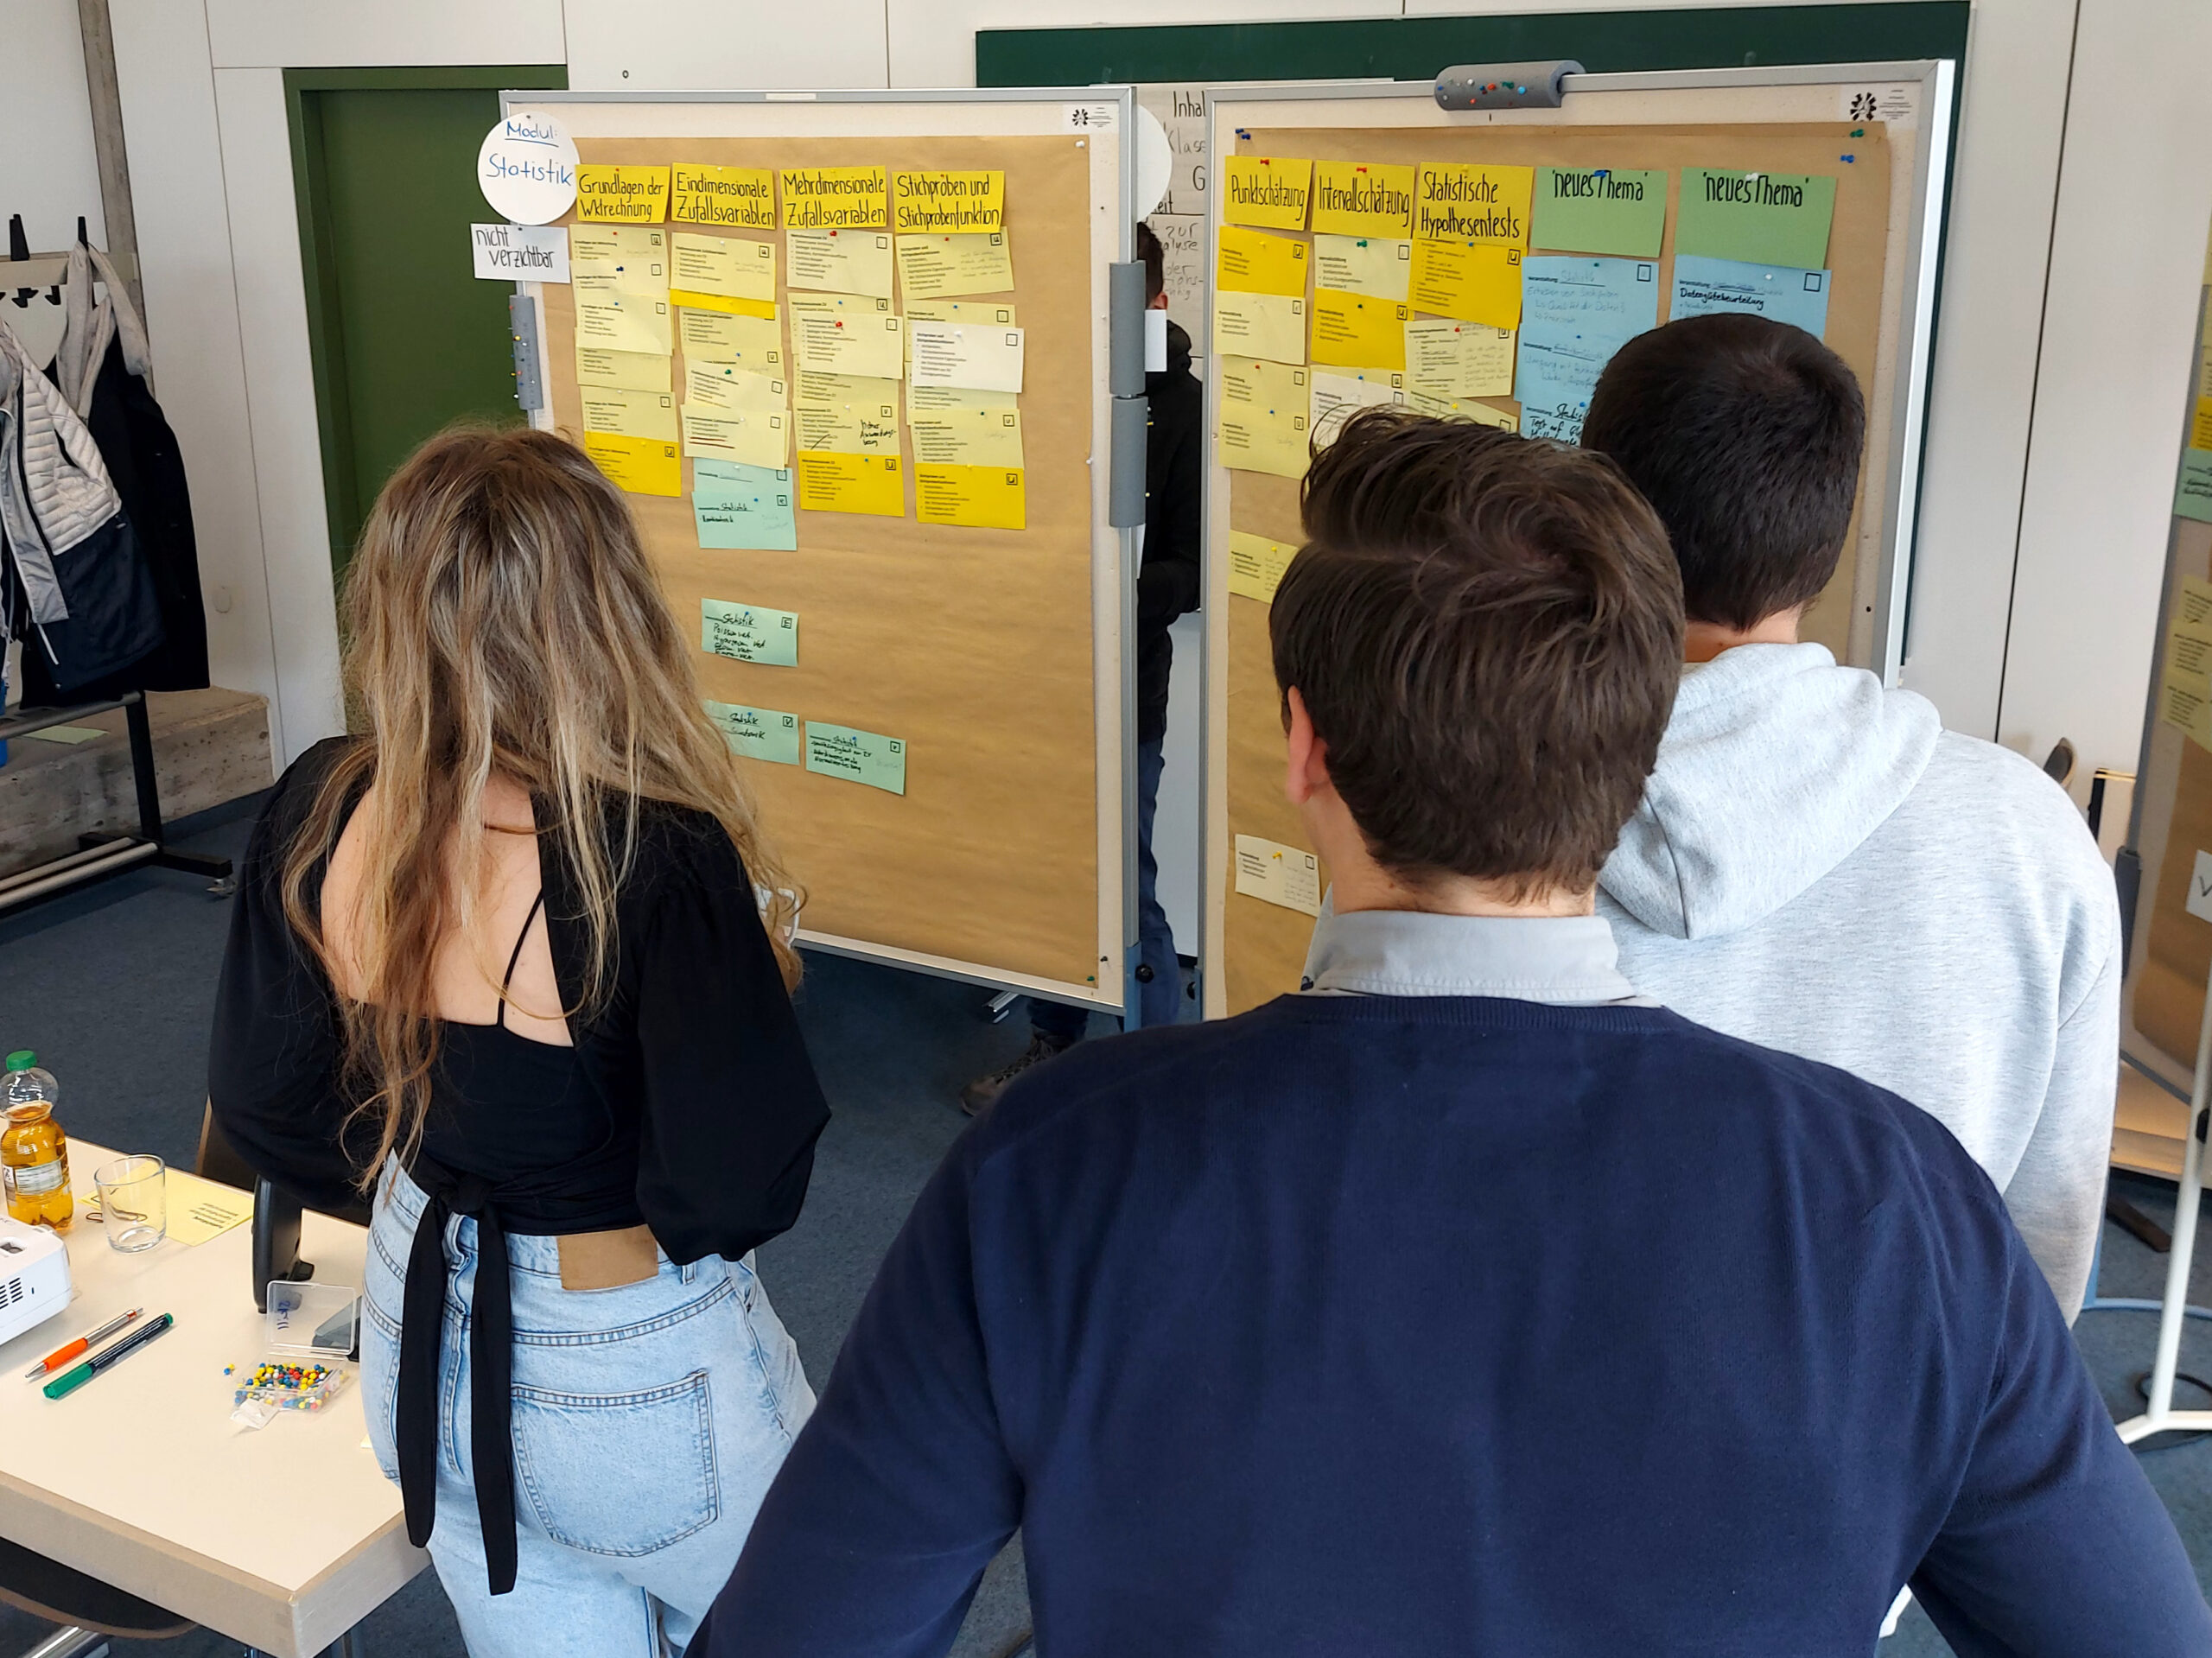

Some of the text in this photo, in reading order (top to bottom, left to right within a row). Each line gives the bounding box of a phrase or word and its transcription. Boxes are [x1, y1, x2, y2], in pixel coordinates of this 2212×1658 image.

[506, 121, 557, 139] Modul:
[579, 173, 664, 203] Grundlagen der
[677, 172, 769, 198] Eindimensionale
[783, 170, 885, 196] Mehrdimensionale
[897, 173, 989, 203] Stichproben und
[1230, 175, 1305, 221] Punktschätzung
[1423, 171, 1499, 203] Statistische
[677, 195, 774, 226] Zufallsvariablen
[785, 199, 885, 229] Zufallsvariablen
[1421, 206, 1520, 238] Hypothesentests
[476, 226, 509, 247] nicht
[488, 245, 554, 268] verzichtbar
